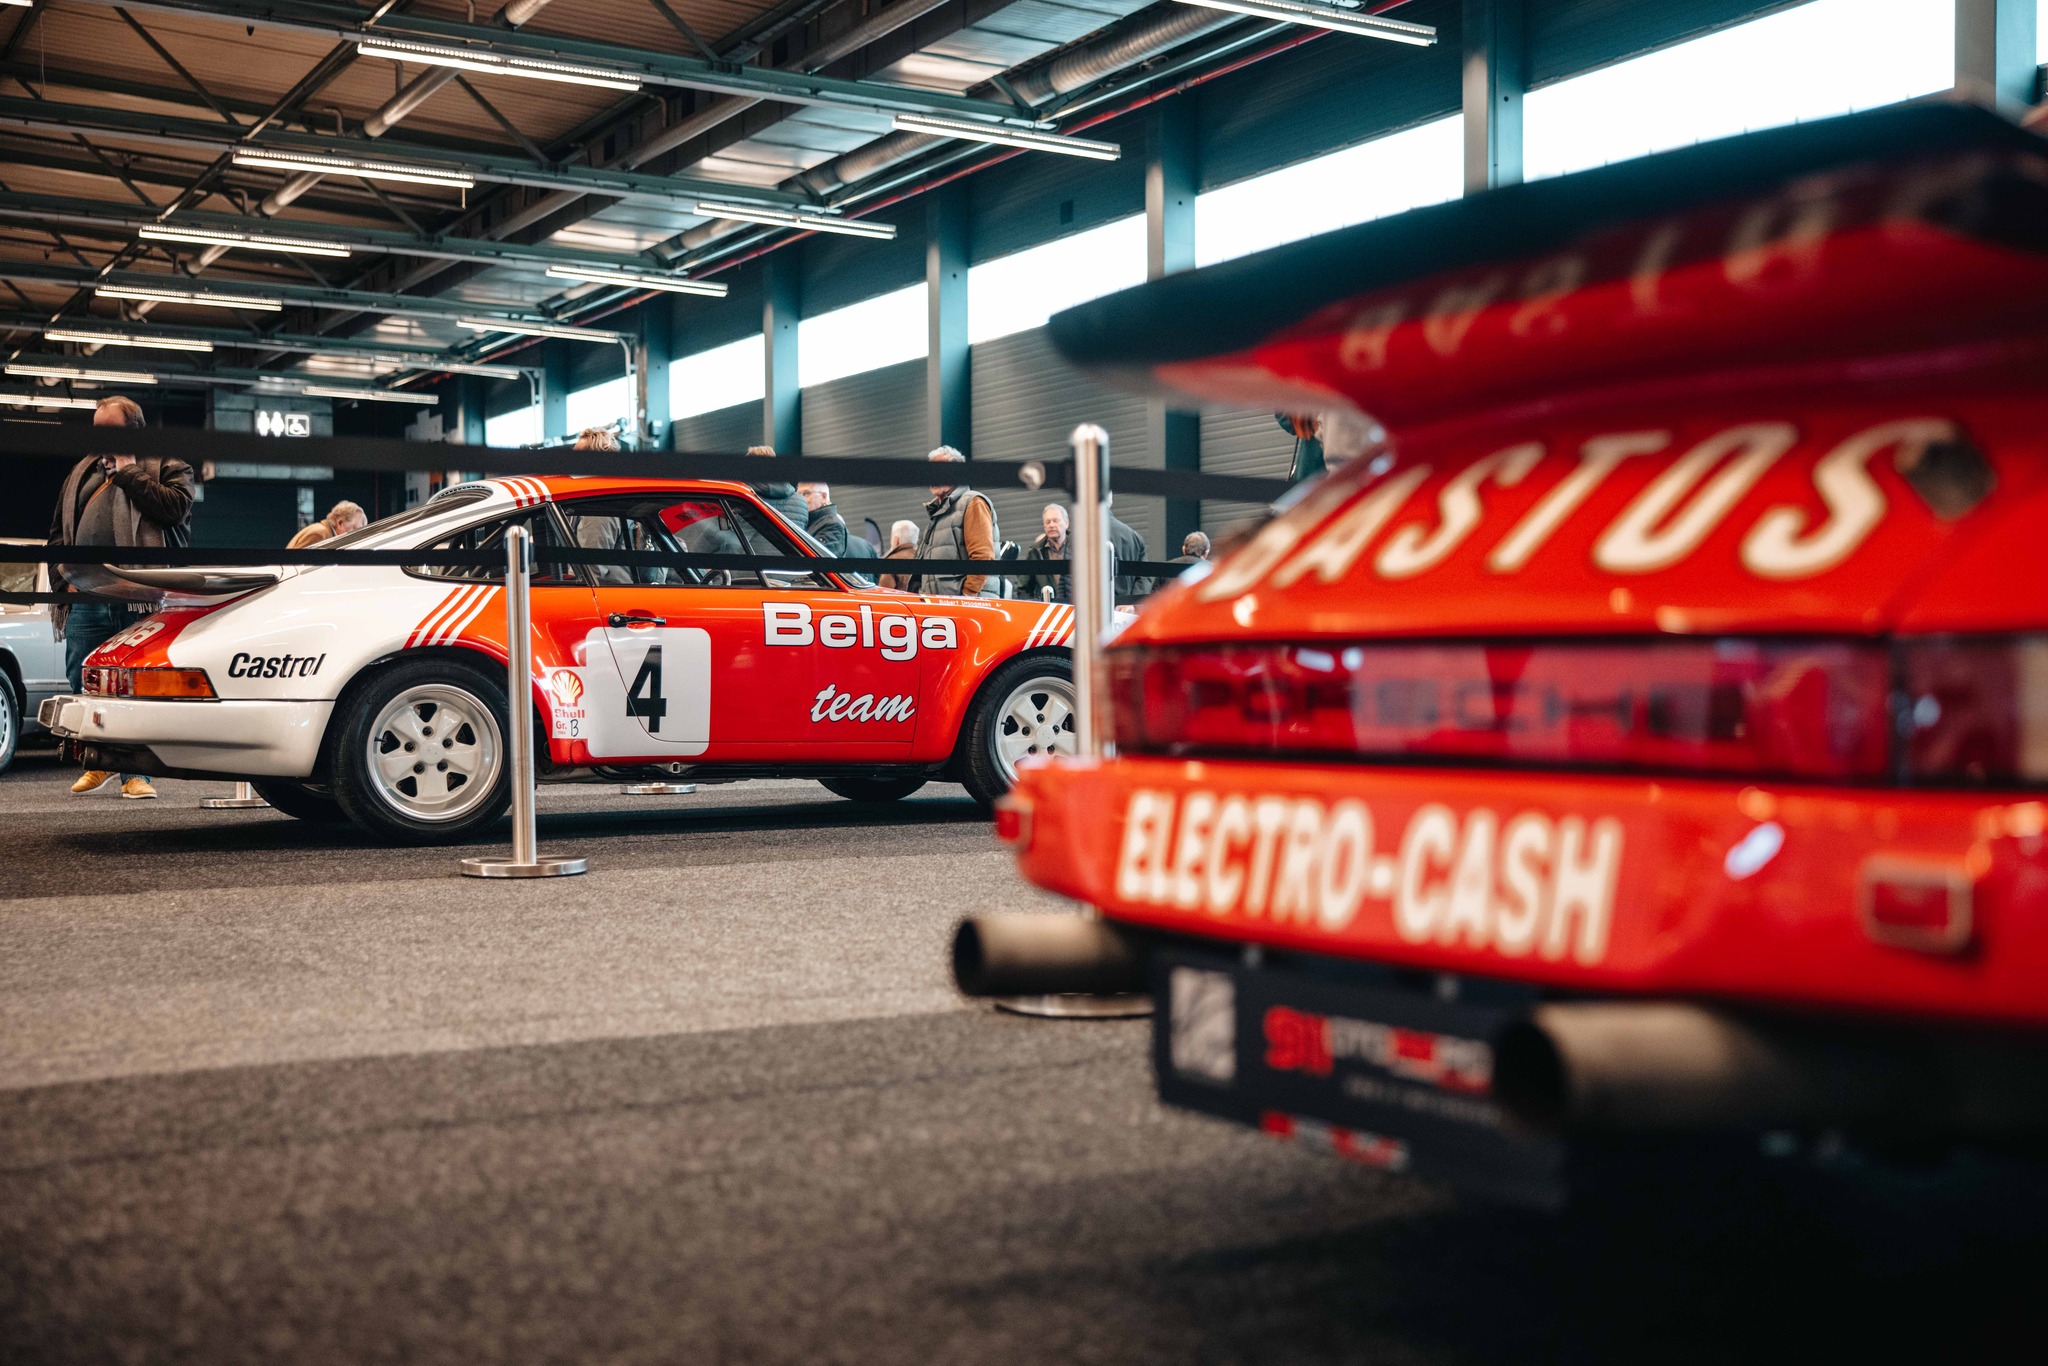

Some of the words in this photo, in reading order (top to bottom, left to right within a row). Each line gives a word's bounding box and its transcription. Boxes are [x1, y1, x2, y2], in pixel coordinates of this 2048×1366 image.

[1202, 416, 1958, 599] BASTOS
[762, 602, 958, 662] Belga
[228, 652, 327, 679] Castrol
[626, 645, 667, 733] 4
[810, 684, 916, 723] team
[554, 708, 585, 719] Shell
[555, 720, 567, 730] Gr.
